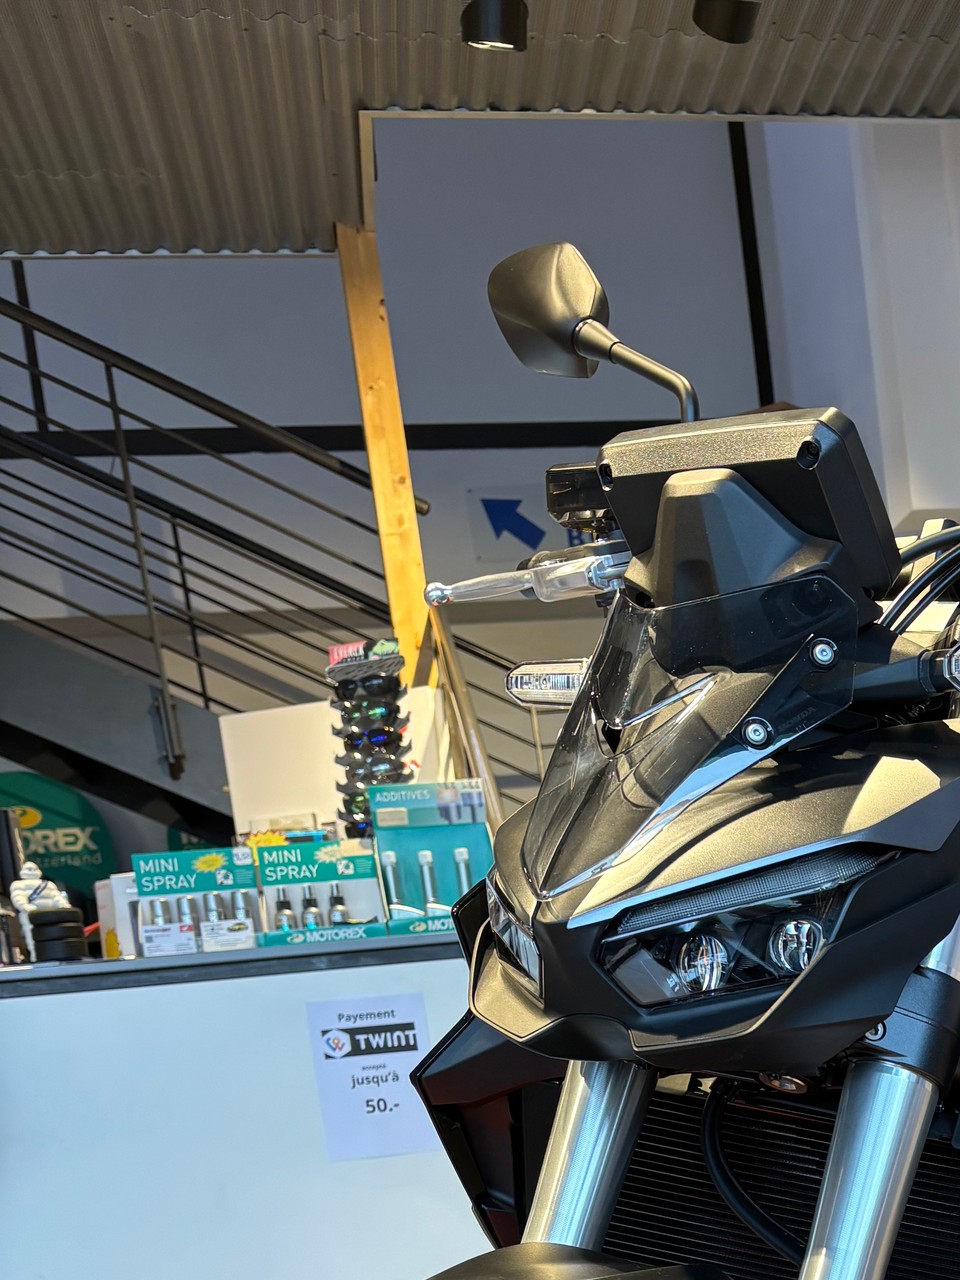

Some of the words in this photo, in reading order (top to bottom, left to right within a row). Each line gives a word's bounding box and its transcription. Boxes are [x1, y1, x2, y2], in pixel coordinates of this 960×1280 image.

[375, 789, 431, 802] ADDITIVES
[20, 826, 100, 855] OREX
[263, 849, 301, 864] MINI
[139, 857, 179, 874] MINI
[265, 864, 319, 882] SPRAY
[141, 873, 197, 892] SPRAY
[306, 927, 366, 943] MOTOREX
[337, 1009, 397, 1024] Payement
[355, 1030, 416, 1050] TWINT
[351, 1071, 400, 1089] jusqu'à
[366, 1098, 400, 1114] 50.-
